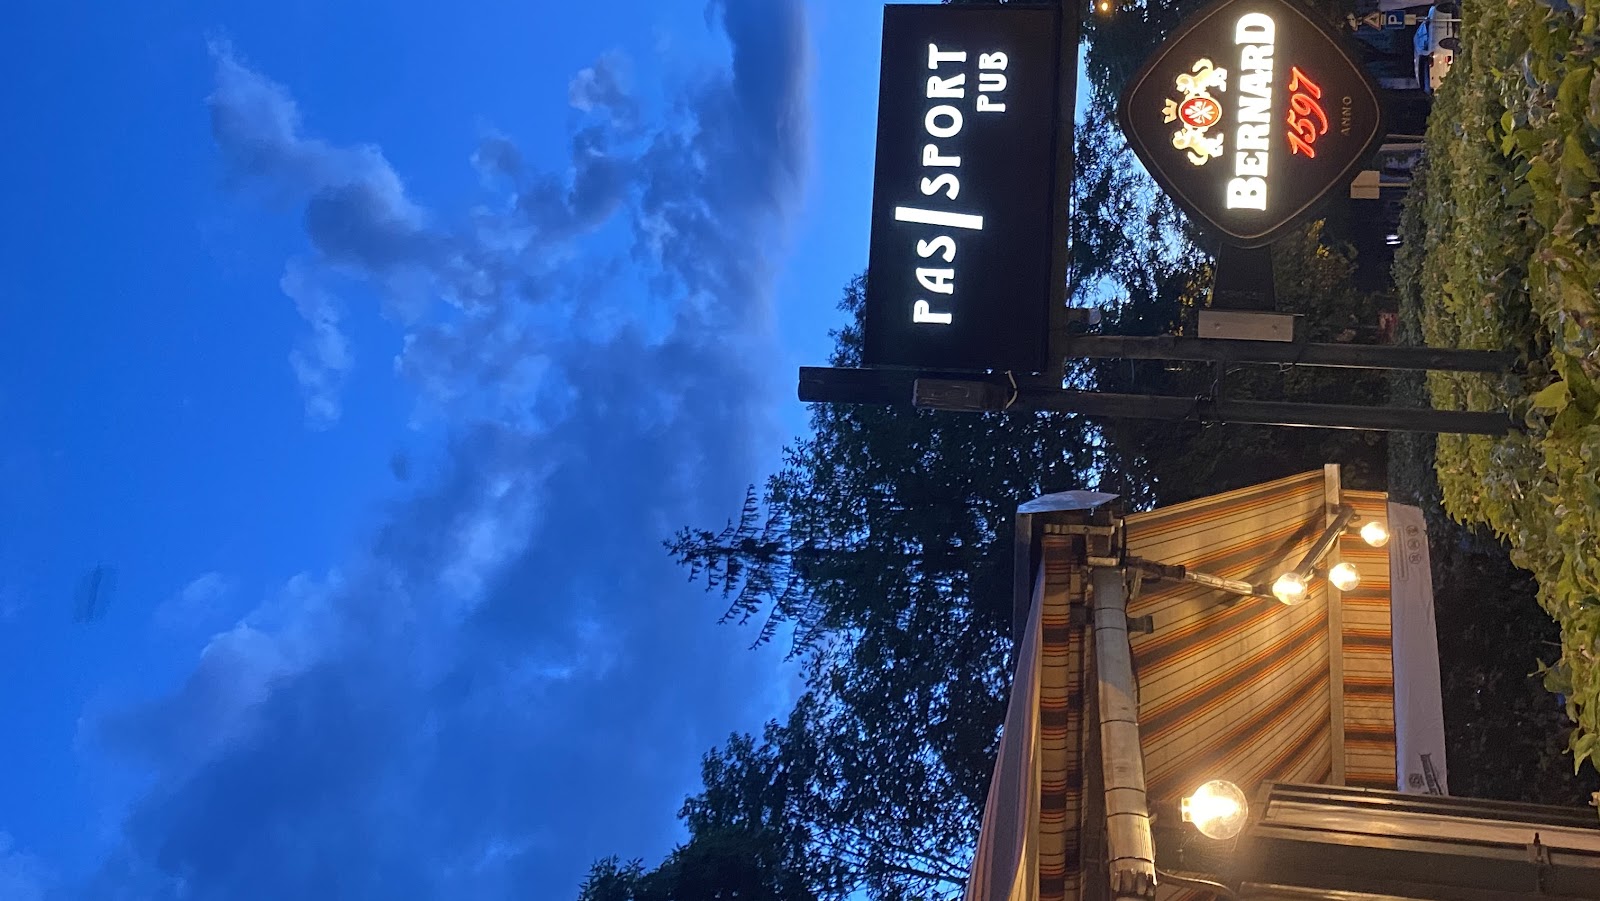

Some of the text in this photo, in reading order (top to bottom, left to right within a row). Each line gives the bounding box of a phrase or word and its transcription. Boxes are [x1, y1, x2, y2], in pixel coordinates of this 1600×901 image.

[1388, 14, 1402, 25] P
[976, 51, 1009, 113] PUB
[1226, 12, 1276, 211] BERNARD
[1287, 66, 1328, 158] 1597
[1341, 96, 1352, 136] ANNO
